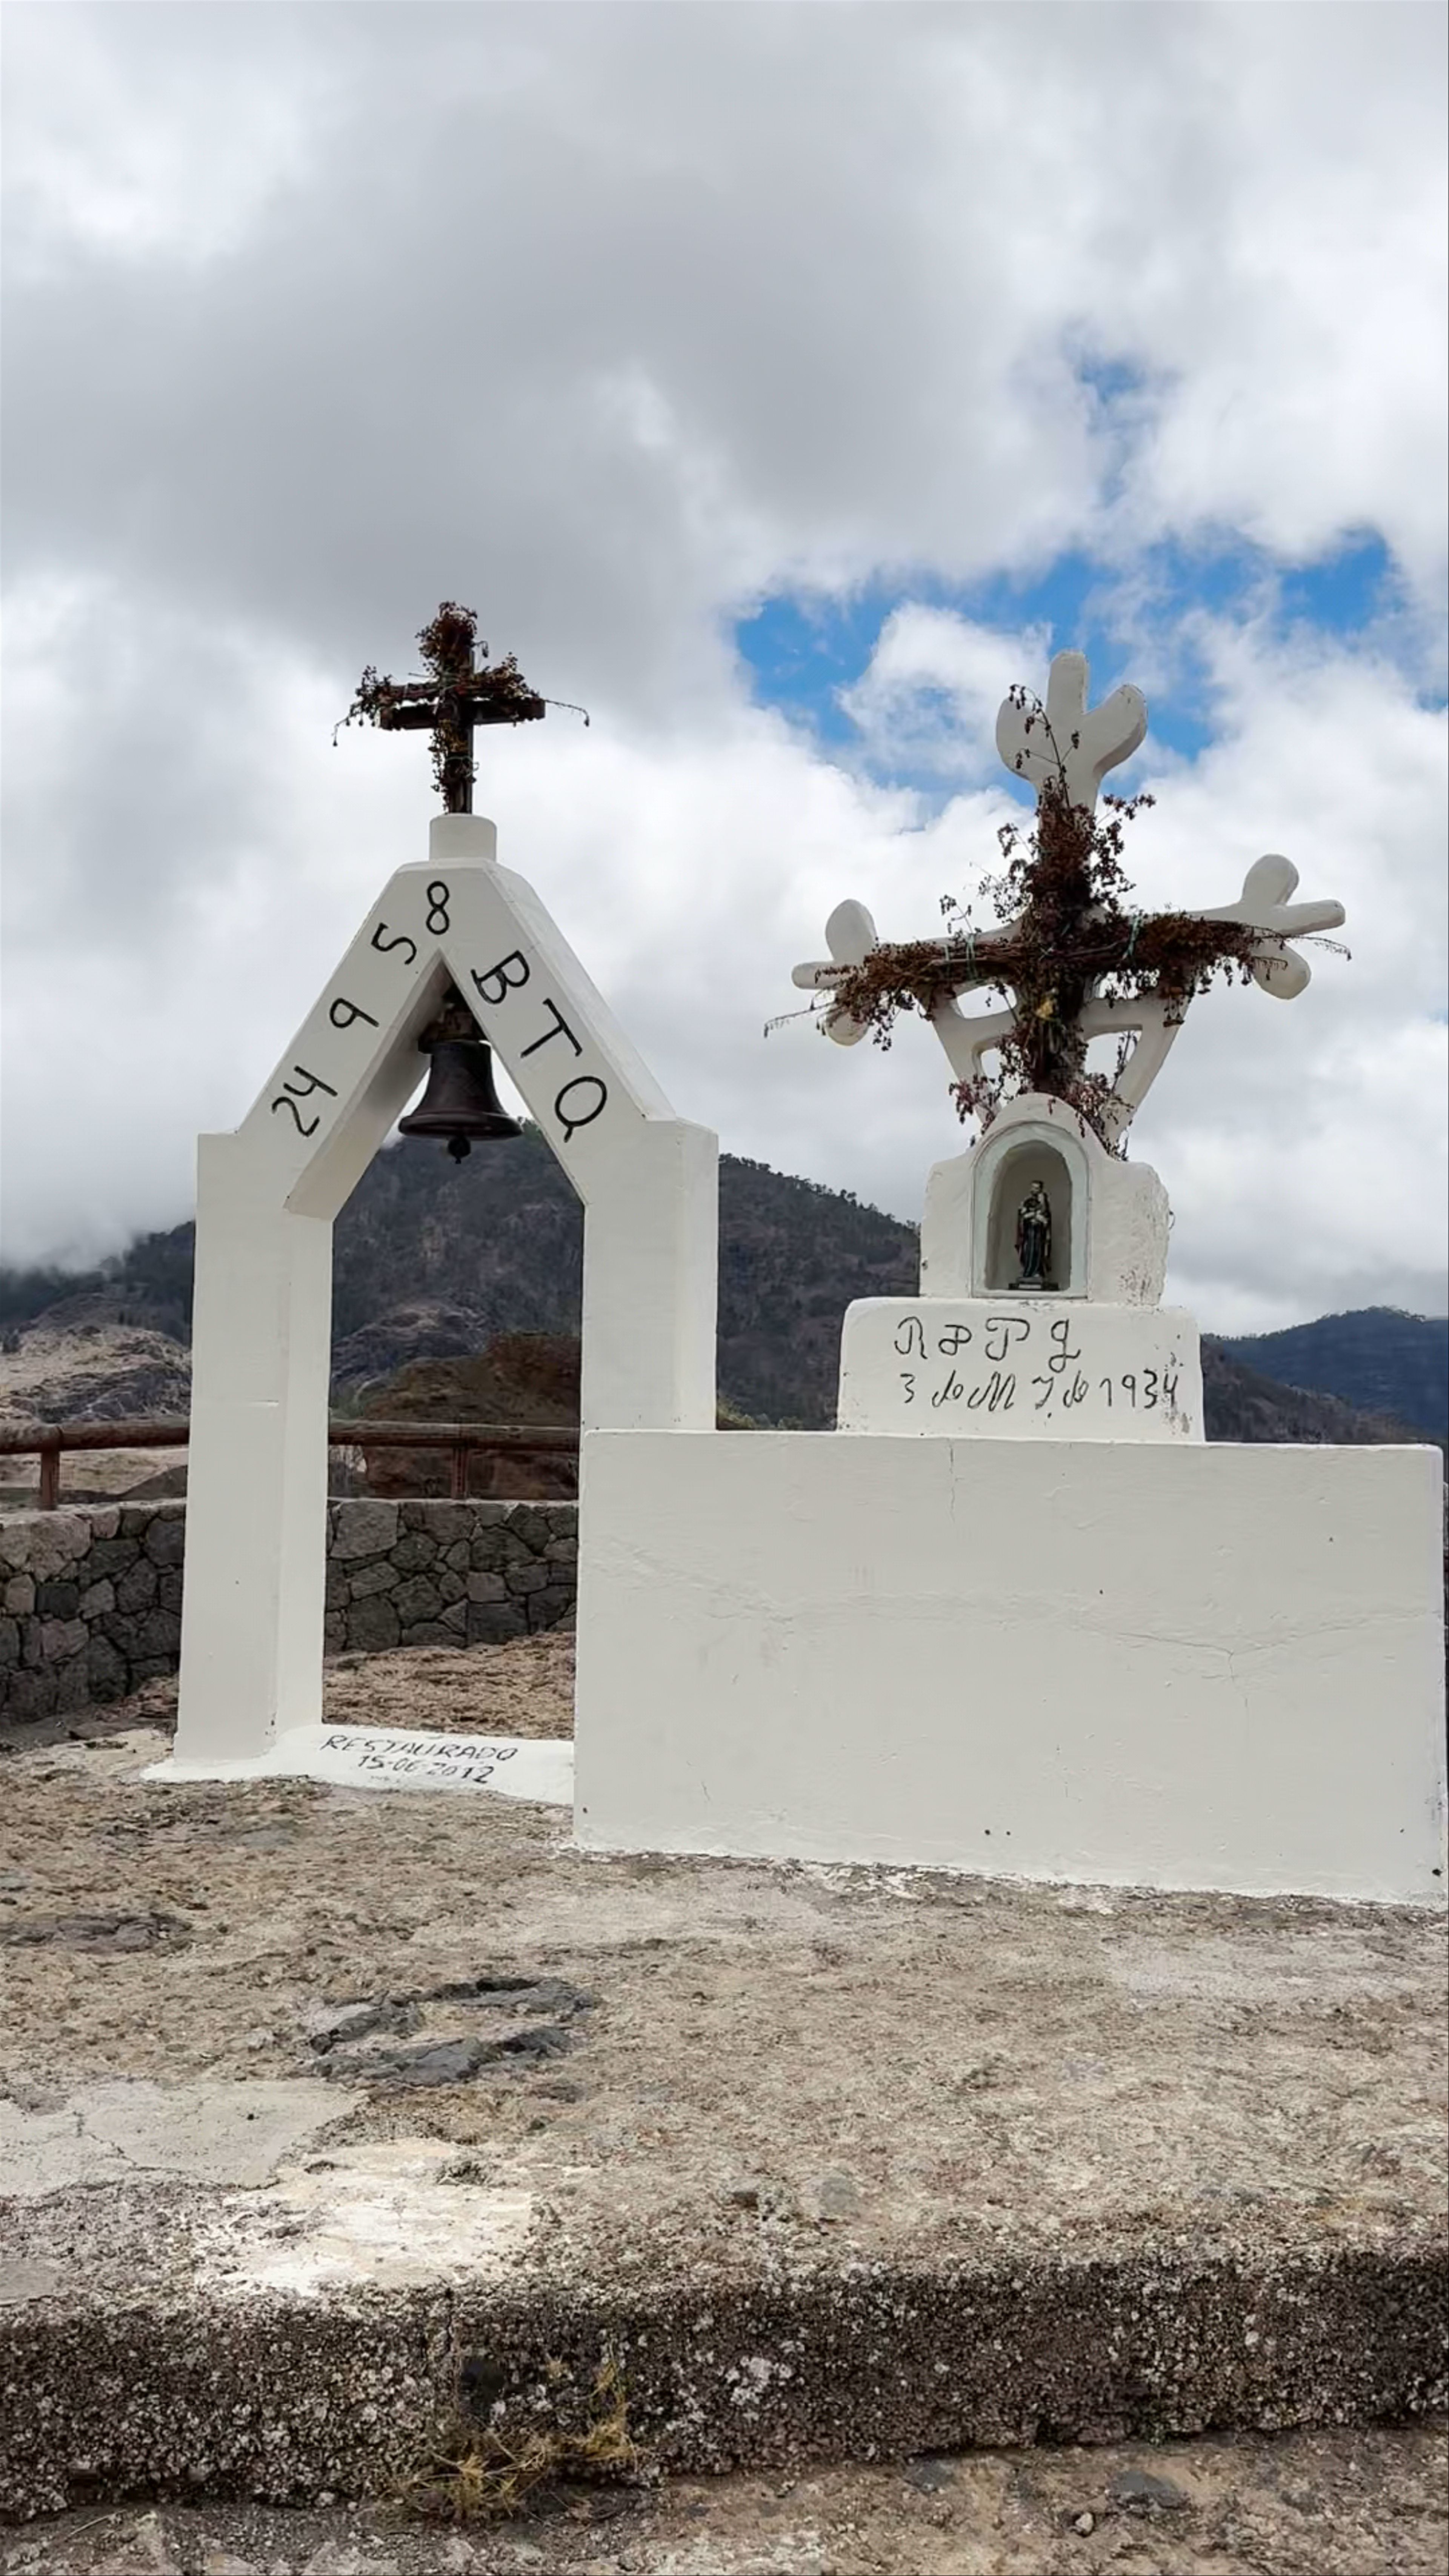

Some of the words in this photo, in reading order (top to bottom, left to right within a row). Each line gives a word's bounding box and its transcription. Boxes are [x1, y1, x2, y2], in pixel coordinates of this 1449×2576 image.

[271, 1065, 338, 1138] 24
[329, 997, 380, 1029] 9
[900, 1372, 916, 1404] 3
[1099, 1367, 1178, 1410] 1934
[320, 1735, 518, 1762] RESTAURADO
